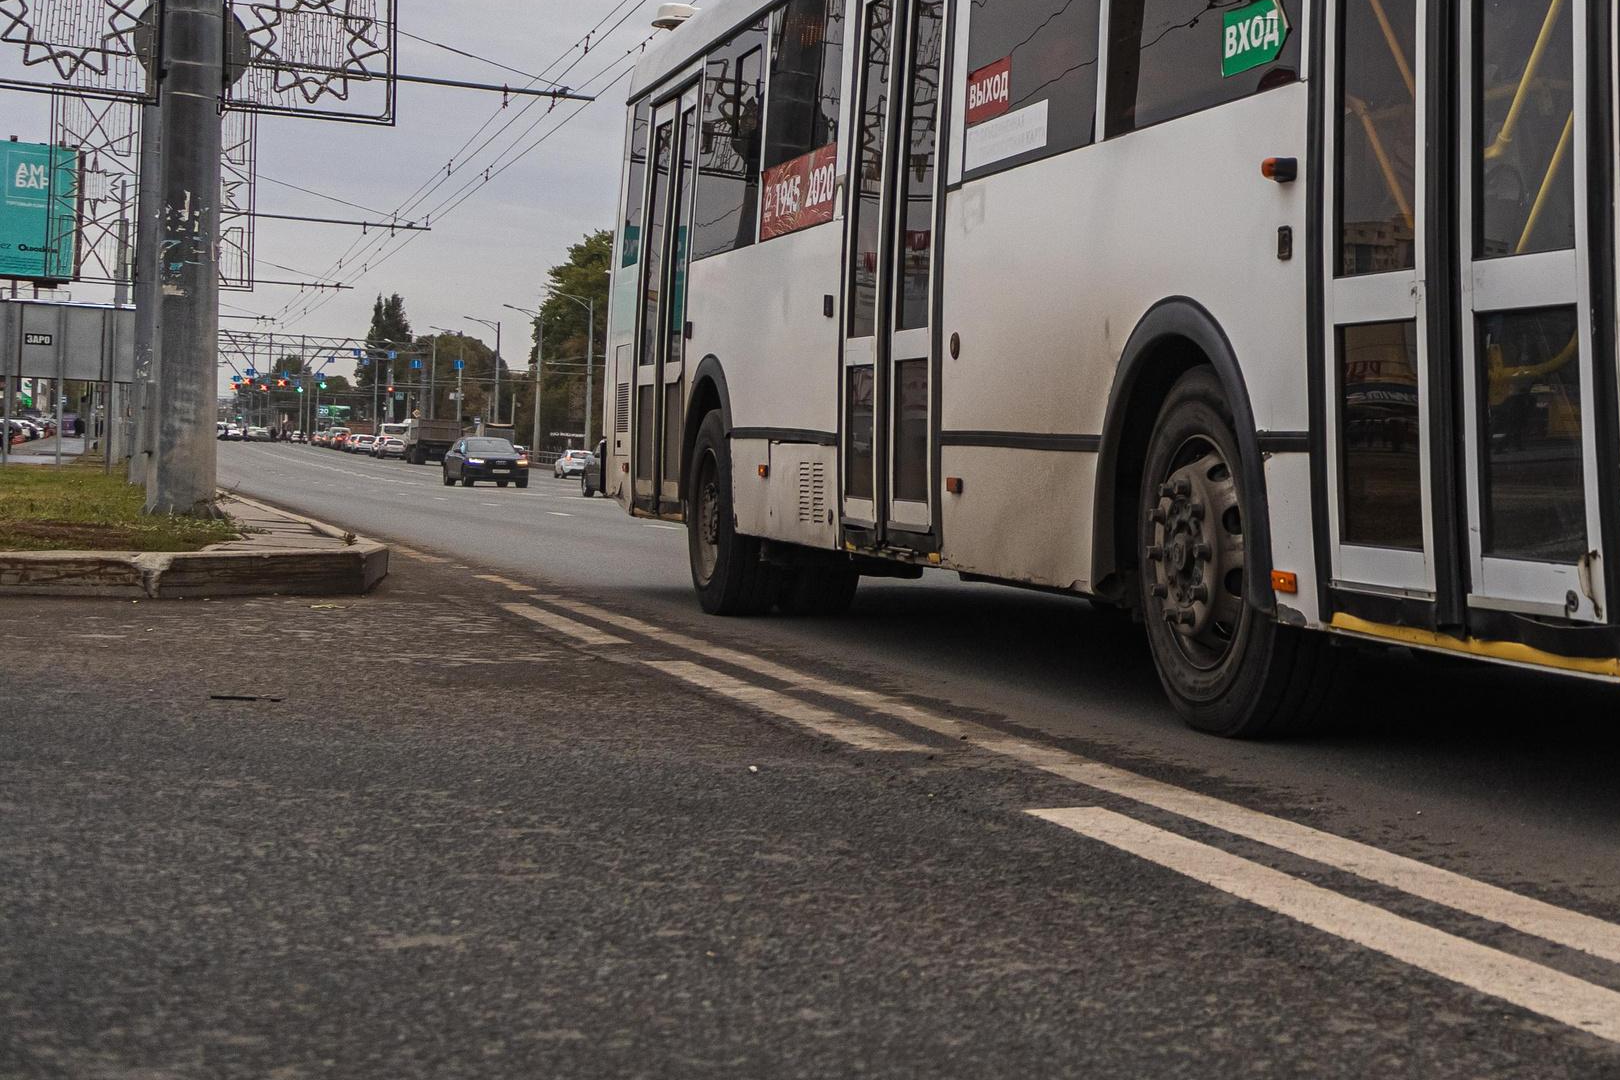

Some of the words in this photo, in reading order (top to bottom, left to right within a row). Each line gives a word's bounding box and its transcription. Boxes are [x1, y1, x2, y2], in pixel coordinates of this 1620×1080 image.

[1225, 9, 1279, 59] ВХОД
[969, 71, 1009, 110] ВЫХОД
[17, 162, 44, 176] АМ
[775, 174, 801, 217] 1945
[805, 163, 835, 208] 2020
